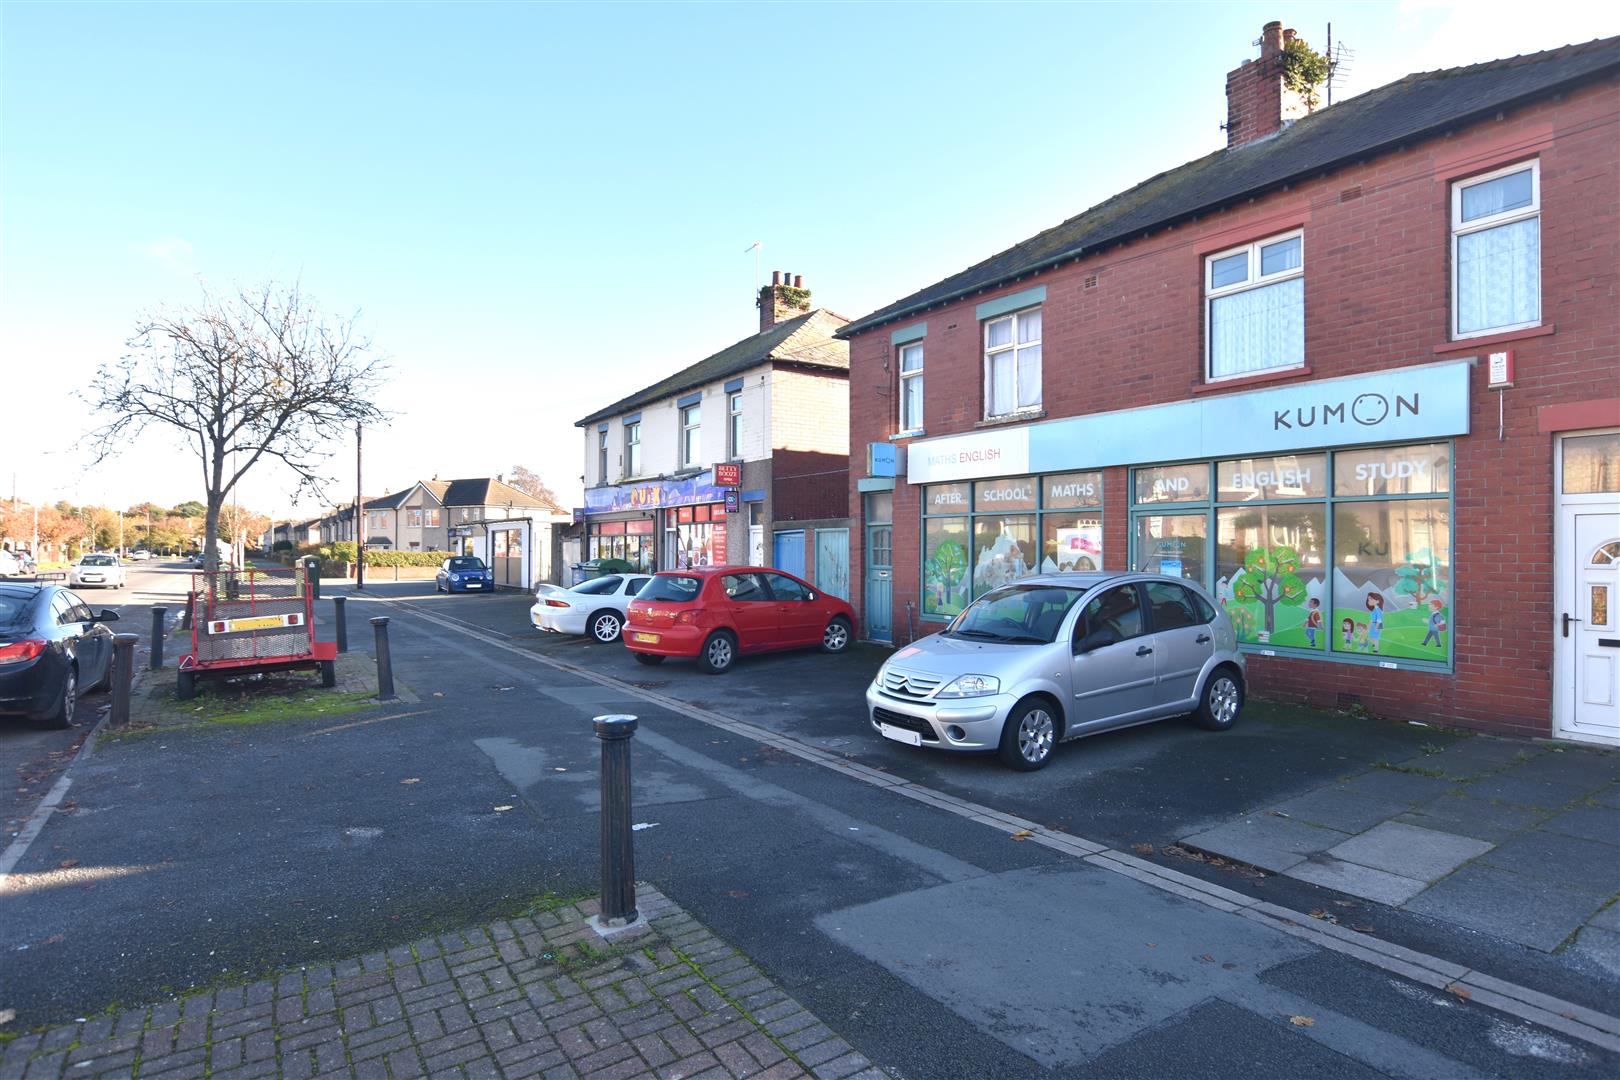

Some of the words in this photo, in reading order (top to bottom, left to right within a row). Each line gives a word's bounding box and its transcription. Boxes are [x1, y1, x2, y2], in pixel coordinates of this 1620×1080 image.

[1274, 392, 1419, 431] KUMON
[928, 454, 957, 467] MATHS
[959, 448, 1001, 463] ENGLISH
[934, 493, 962, 505] AFTER
[983, 487, 1029, 501] SCHOOL
[1051, 483, 1095, 498] MATHS
[1155, 477, 1189, 492] AND
[1232, 468, 1311, 489] ENGLISH
[1355, 459, 1428, 480] STUDY
